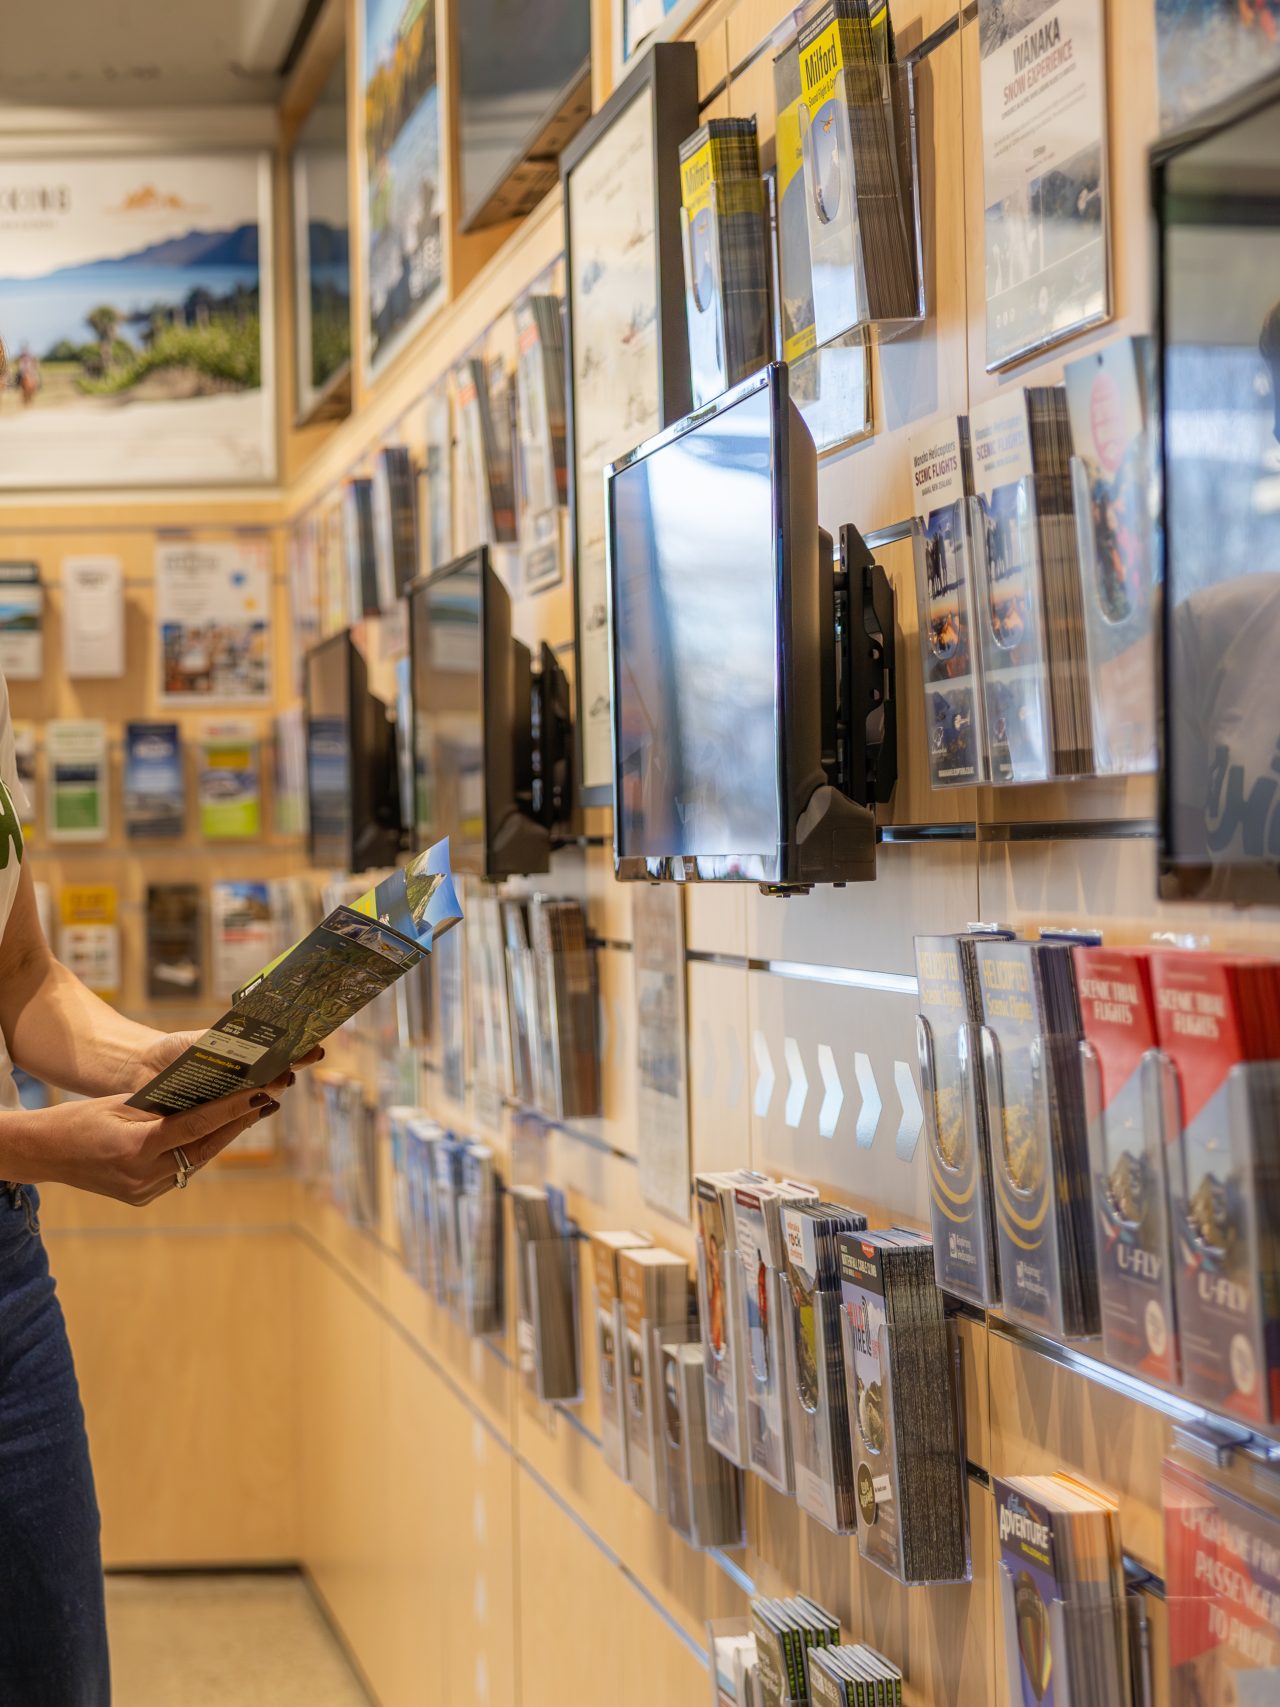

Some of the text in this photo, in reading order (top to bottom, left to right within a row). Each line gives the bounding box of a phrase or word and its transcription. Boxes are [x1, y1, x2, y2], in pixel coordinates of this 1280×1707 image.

[804, 33, 838, 90] Milford
[1003, 75, 1026, 106] SNOW
[1027, 38, 1073, 88] EXPERIENCE
[685, 152, 711, 196] Milford
[928, 441, 956, 461] Helicopters
[914, 465, 932, 487] SCENIC
[931, 456, 958, 477] FLIGHTS
[1080, 978, 1110, 1000] SCENIC
[1093, 1001, 1133, 1025] FLIGHTS
[1117, 1243, 1162, 1280] U-FLY
[1198, 1272, 1248, 1313] U-FLY
[1000, 1504, 1049, 1549] ADVENTURE
